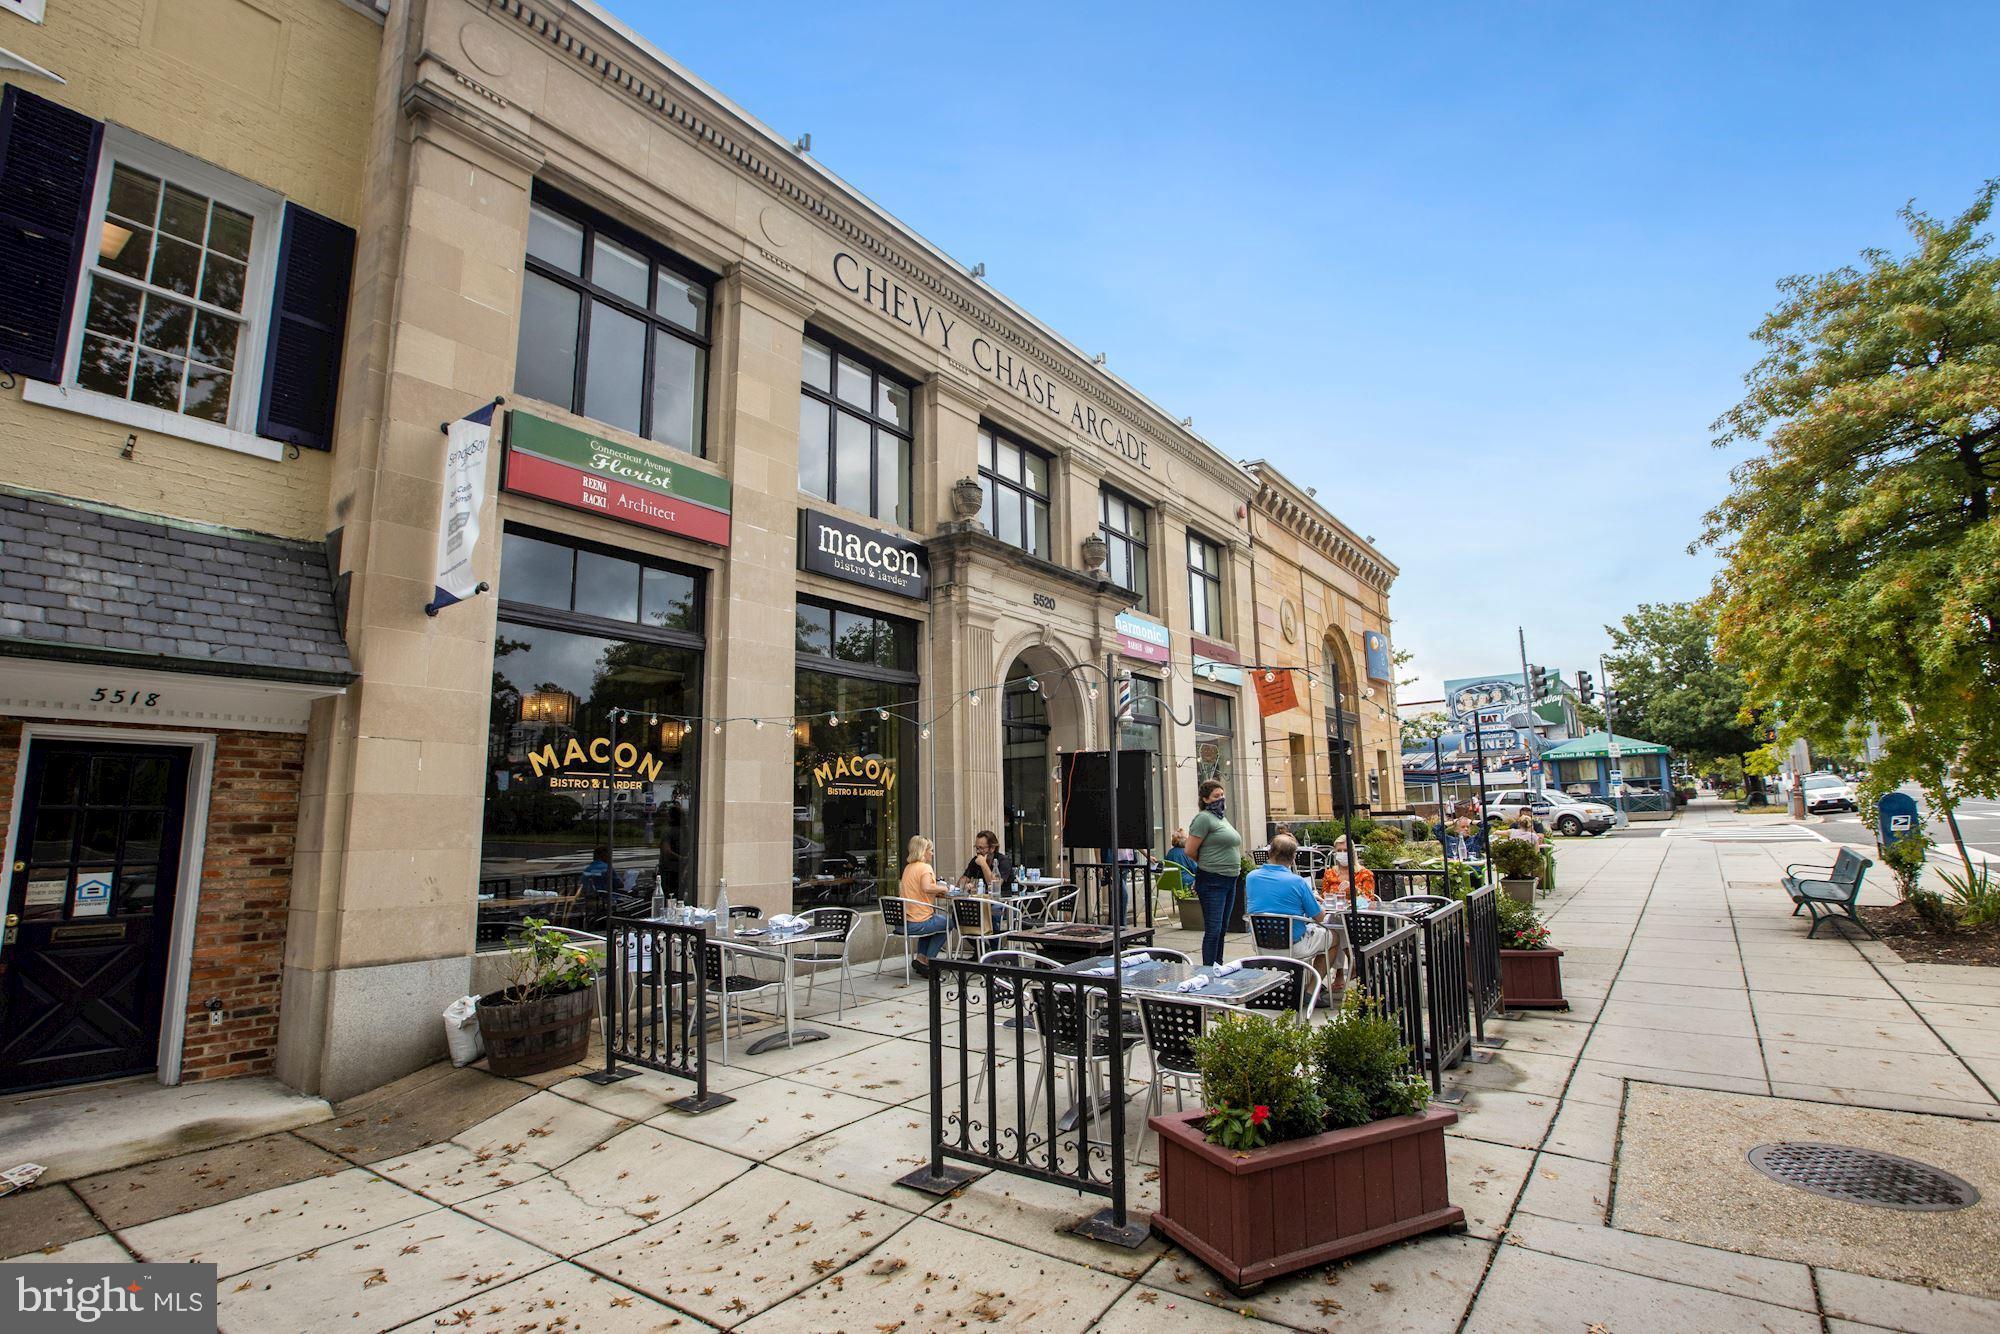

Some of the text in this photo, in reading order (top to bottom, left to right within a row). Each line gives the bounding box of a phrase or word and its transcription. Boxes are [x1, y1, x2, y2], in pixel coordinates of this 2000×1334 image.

[833, 252, 1151, 470] CHEVY CHASE ARCADE
[590, 440, 672, 475] Connecticut Avenue
[589, 453, 671, 489] Florist
[582, 476, 607, 493] REENA
[583, 491, 607, 508] RACKI
[617, 493, 676, 521] Architect
[818, 525, 921, 578] macon
[834, 558, 908, 587] bistro & larder
[1033, 593, 1056, 611] 5520
[90, 687, 161, 707] 5518
[1480, 714, 1498, 723] EAT
[1469, 738, 1516, 750] DINER
[527, 737, 664, 783] MACON
[550, 777, 589, 789] BISTRO
[591, 778, 600, 789] &
[813, 755, 896, 791] MACON
[827, 787, 885, 797] BISTRO & LARDER
